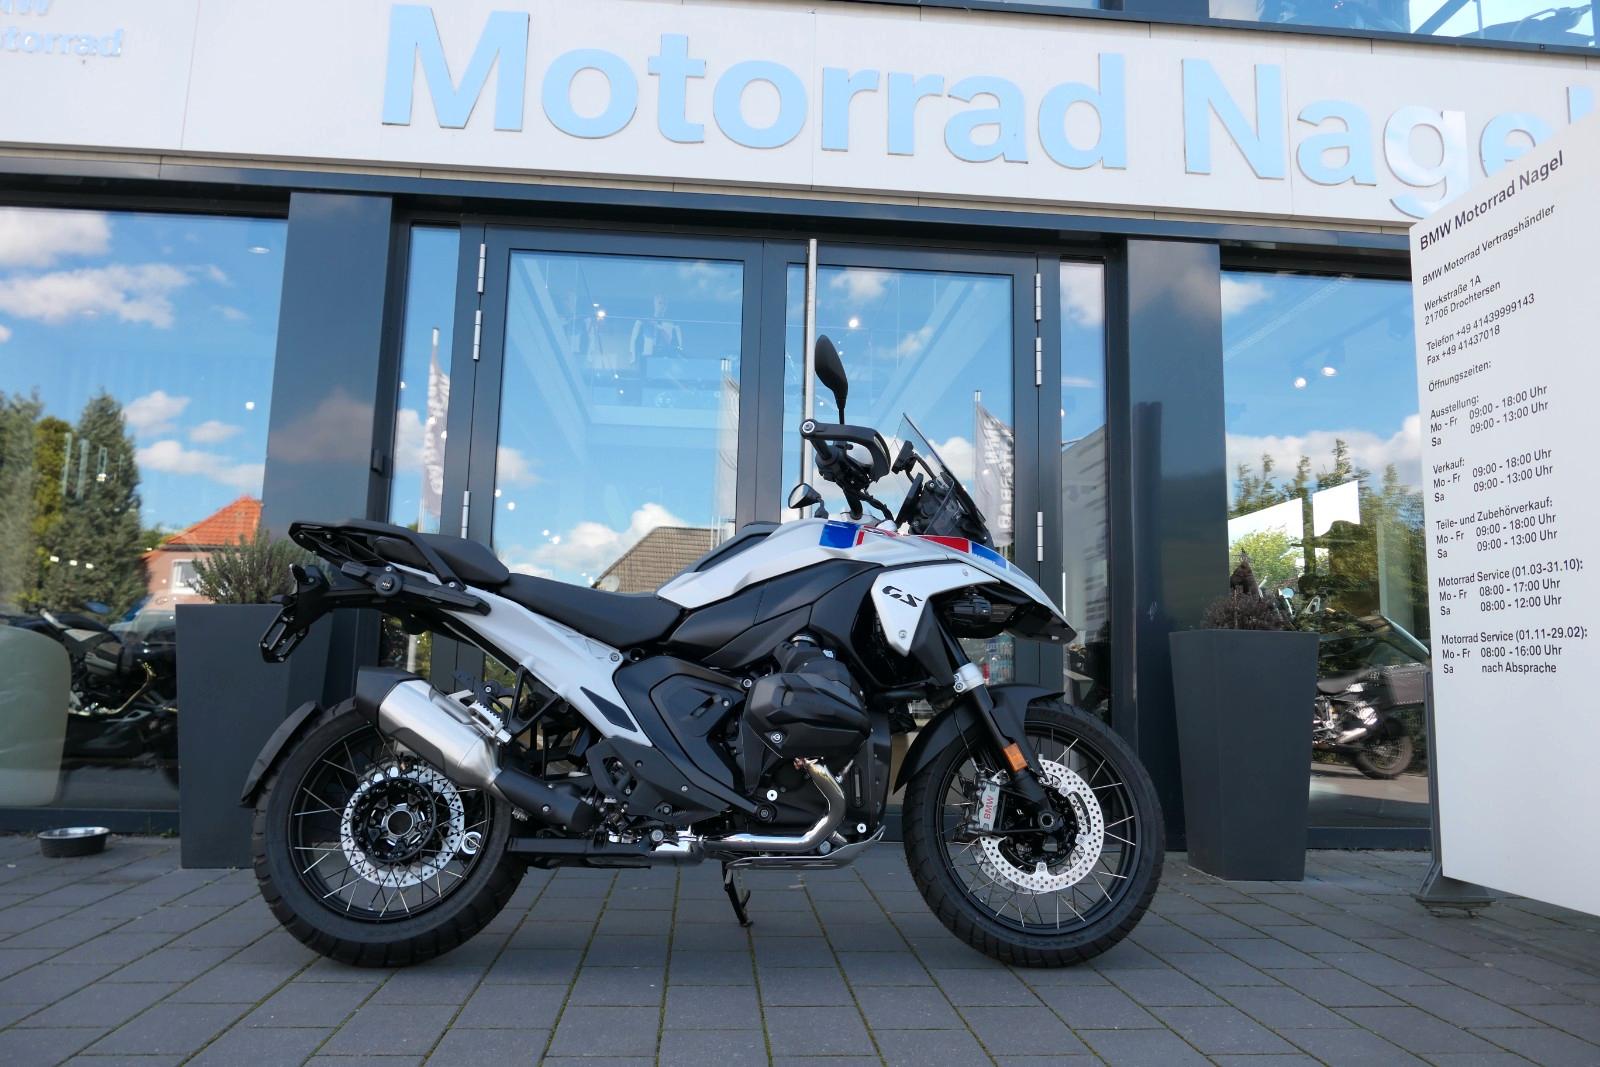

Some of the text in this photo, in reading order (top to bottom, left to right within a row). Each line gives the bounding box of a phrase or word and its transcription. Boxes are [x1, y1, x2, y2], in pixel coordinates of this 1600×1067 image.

[0, 25, 124, 57] torrad
[382, 4, 1127, 170] Motorrad
[1419, 149, 1564, 252] BMW Motorrad Nagel
[1422, 204, 1556, 286] BMW Motorrad Vertragshändler
[1423, 274, 1482, 312] Werkstraße 1A
[1424, 281, 1501, 326] 21706 Drochtersen
[1425, 292, 1535, 352] Telefon +49 41439999143
[1426, 324, 1501, 366] Fax +49 41437018
[1428, 360, 1492, 393] Öffnungszeiten:
[1430, 394, 1480, 420] Ausstellung:
[1430, 422, 1443, 434] Mo
[1449, 415, 1458, 427] Fr
[1469, 402, 1494, 421] 09:00
[1501, 390, 1528, 408] 18:00
[1529, 385, 1548, 399] Uhr
[1431, 436, 1442, 448] Sa
[1470, 417, 1495, 435] 09:00
[1502, 405, 1529, 423] 13:00
[1530, 400, 1549, 415] Uhr
[1432, 456, 1465, 475] Verkauf:
[1433, 477, 1446, 489] Mo
[1452, 472, 1461, 484] Fr
[1472, 462, 1497, 478] 09:00
[1505, 452, 1532, 469] 18:00
[1533, 448, 1552, 462] Uhr
[1434, 492, 1445, 503] Sa
[1473, 477, 1498, 493] 09:00
[1506, 468, 1533, 485] 13:00
[1534, 464, 1554, 478] Uhr
[1435, 495, 1553, 531] Teile- und Zubehörverkauf:
[1436, 533, 1449, 545] Mo
[1455, 530, 1465, 541] Fr
[1475, 522, 1501, 538] 09:00
[1509, 515, 1536, 531] 18:00
[1537, 512, 1557, 525] Uhr
[1437, 548, 1448, 559] Sa
[1476, 537, 1502, 552] 09:00
[1510, 531, 1537, 546] 13:00
[1539, 528, 1558, 542] Uhr
[1438, 557, 1584, 588] Motorrad Service (01.03-31.10):
[881, 585, 923, 608] GS
[1439, 590, 1452, 602] Mo
[1458, 588, 1468, 600] Fr
[1479, 583, 1505, 597] 08:00
[1512, 579, 1540, 593] 17:00
[1542, 577, 1561, 590] Uhr
[1440, 605, 1451, 616] Sa
[1480, 599, 1506, 612] 08:00
[1514, 595, 1542, 609] 12:00
[1543, 594, 1562, 607] Uhr
[1441, 625, 1588, 645] Motorrad Service (01.11-29.02):
[1442, 648, 1455, 660] Mo
[1461, 648, 1471, 659] Fr
[1480, 646, 1506, 658] 08:00
[1514, 644, 1542, 657] 16:00
[1543, 643, 1563, 656] Uhr
[1443, 661, 1557, 676] Sa nach Absprache
[983, 795, 994, 820] BMW
